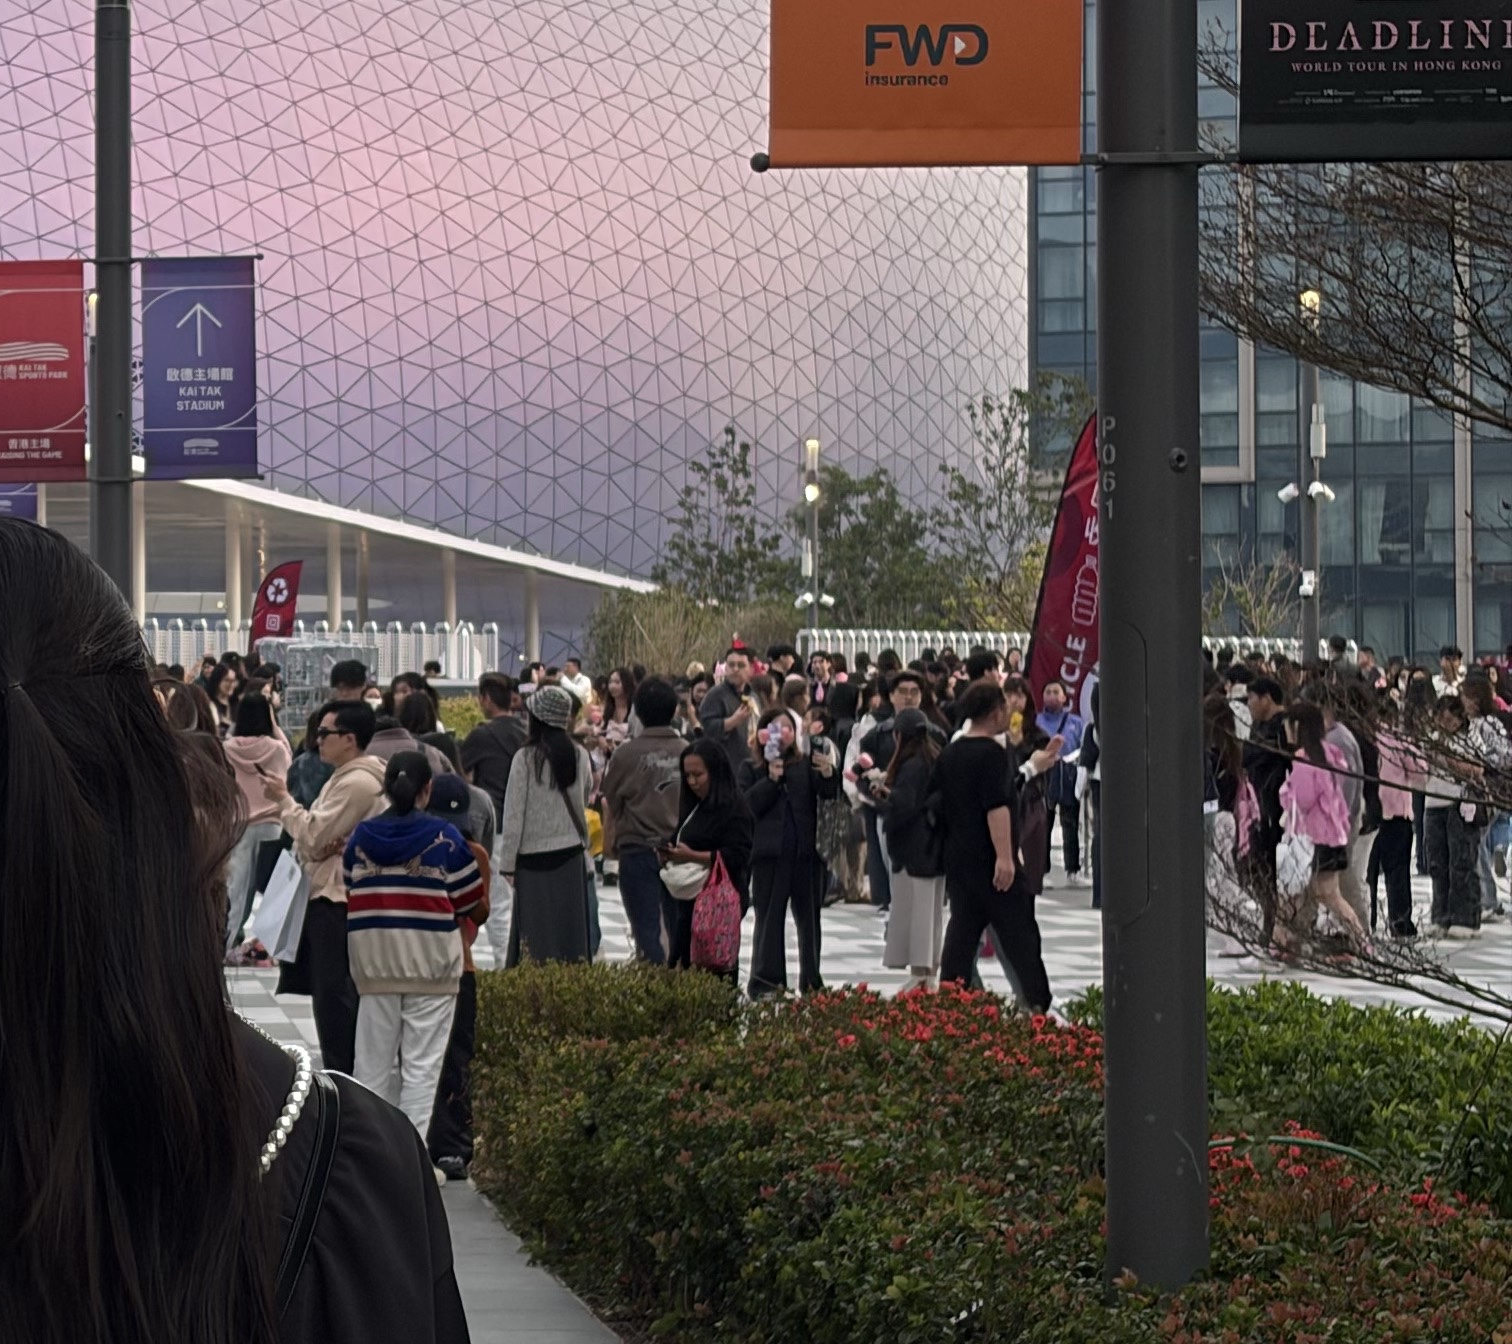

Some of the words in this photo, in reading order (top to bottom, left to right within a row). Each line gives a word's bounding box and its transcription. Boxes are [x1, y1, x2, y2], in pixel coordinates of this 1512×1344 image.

[865, 24, 989, 67] FWD
[1291, 62, 1342, 72] WORLD
[1347, 62, 1387, 72] TOUR
[1392, 62, 1408, 72] IN
[1414, 61, 1455, 71] HONG
[1461, 60, 1502, 70] KONG
[865, 71, 948, 86] insurance
[179, 386, 198, 397] KAI
[200, 386, 222, 397] TAK
[176, 400, 225, 411] STADIUM
